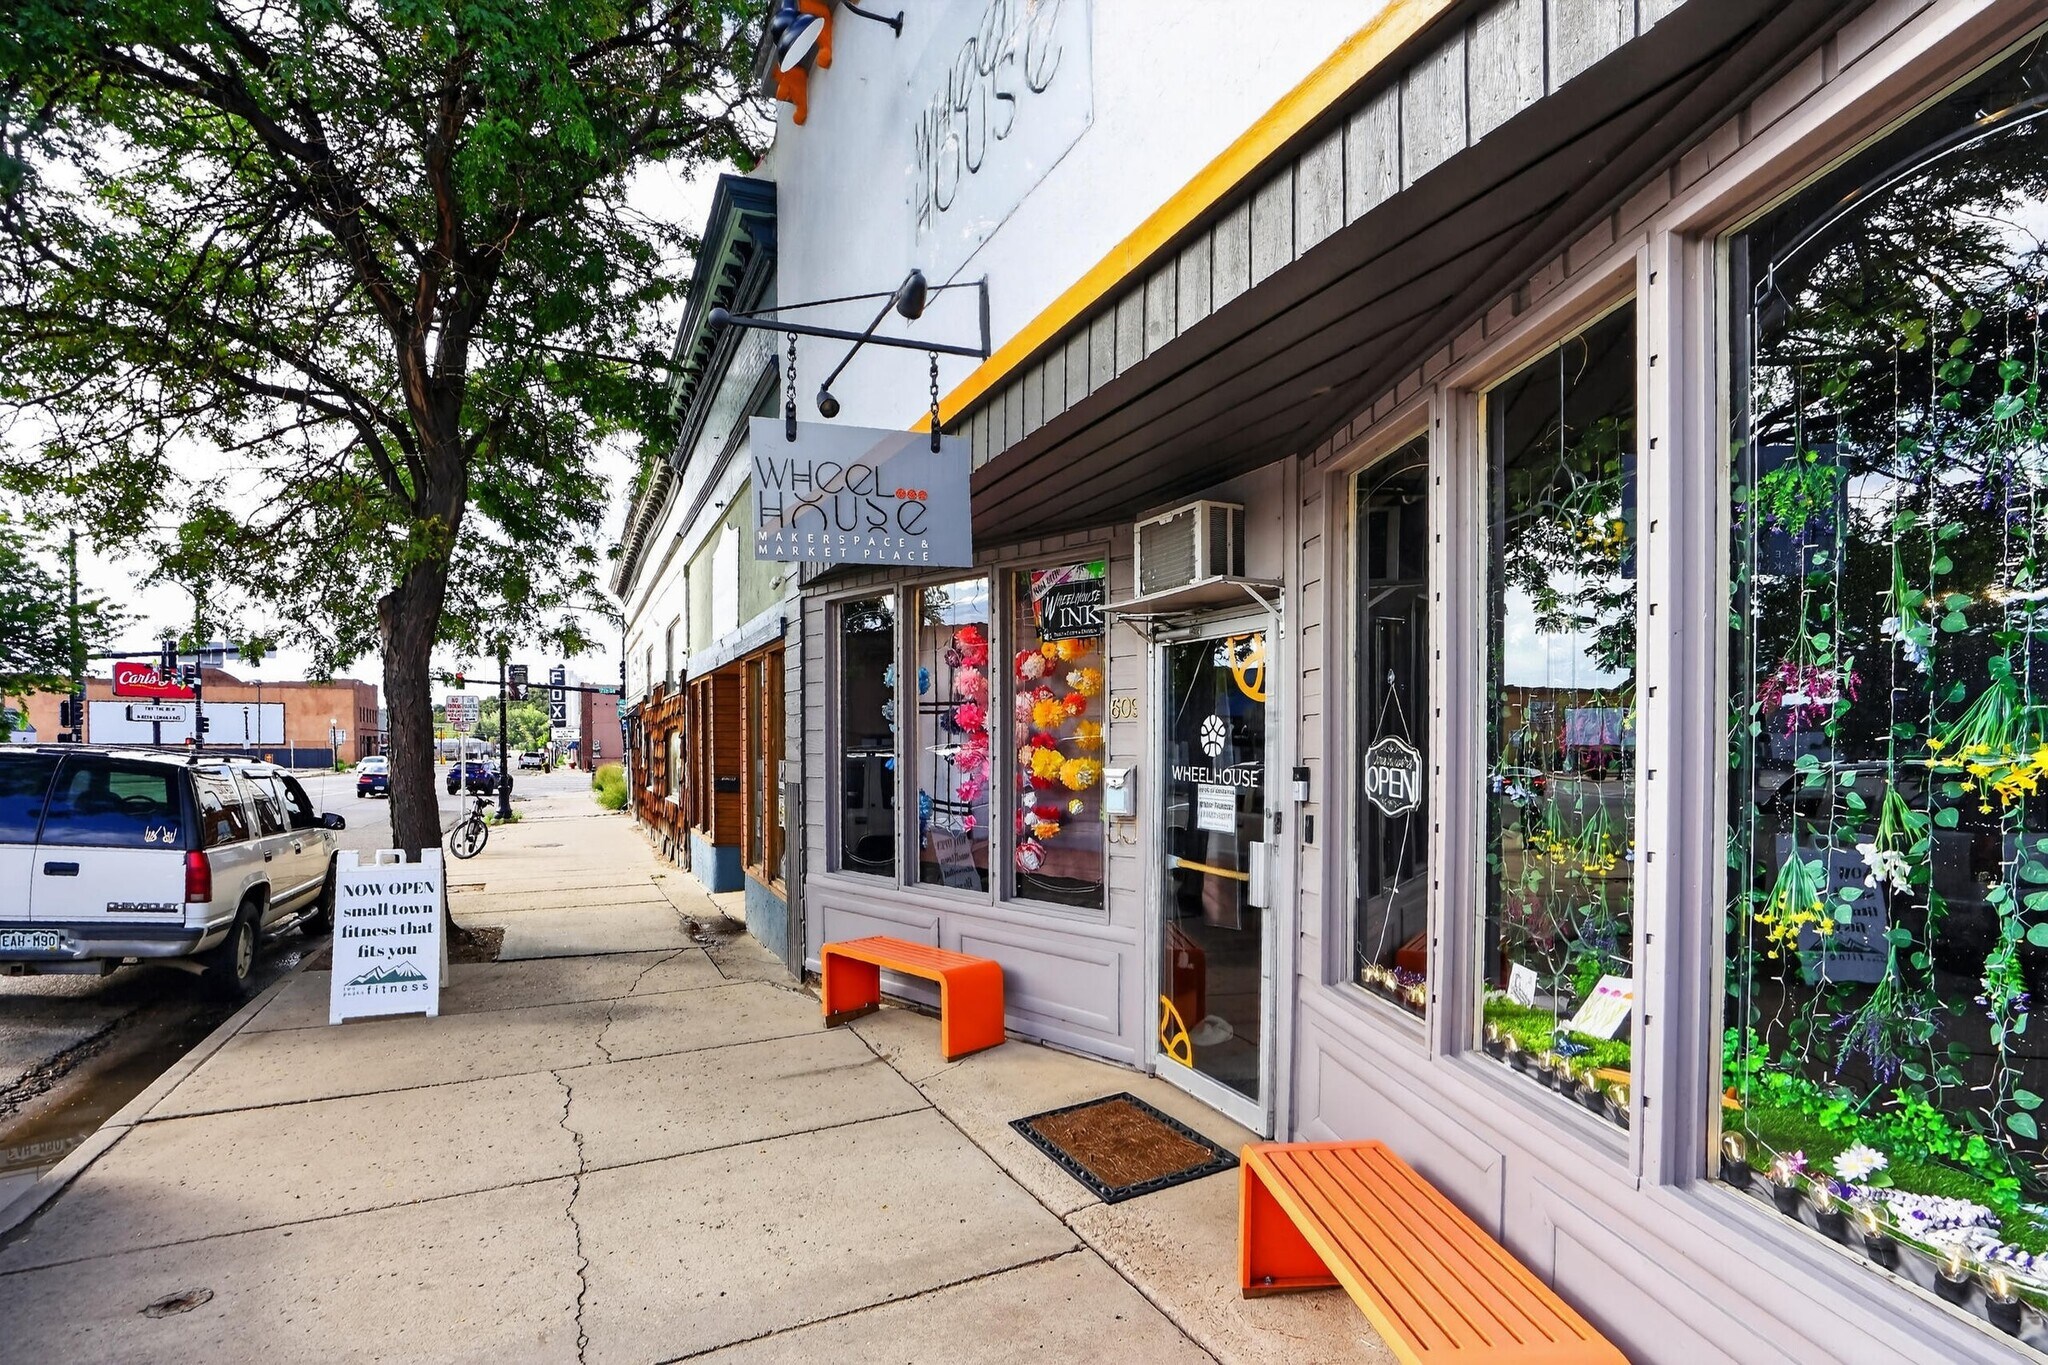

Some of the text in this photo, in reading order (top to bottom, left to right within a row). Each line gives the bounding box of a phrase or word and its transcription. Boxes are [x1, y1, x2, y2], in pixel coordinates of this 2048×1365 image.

[758, 532, 929, 549] MAKERSPACE &
[758, 546, 929, 561] MARKET PLACE
[1060, 603, 1103, 628] INK
[551, 671, 563, 718] FOX
[1171, 764, 1259, 788] WHEELHOUSE
[1367, 765, 1416, 803] OPEN
[343, 881, 434, 898] NOW OPEN
[343, 902, 433, 918] small town
[341, 921, 434, 939] fitness that
[357, 944, 417, 960] fits you
[367, 982, 429, 995] fitness
